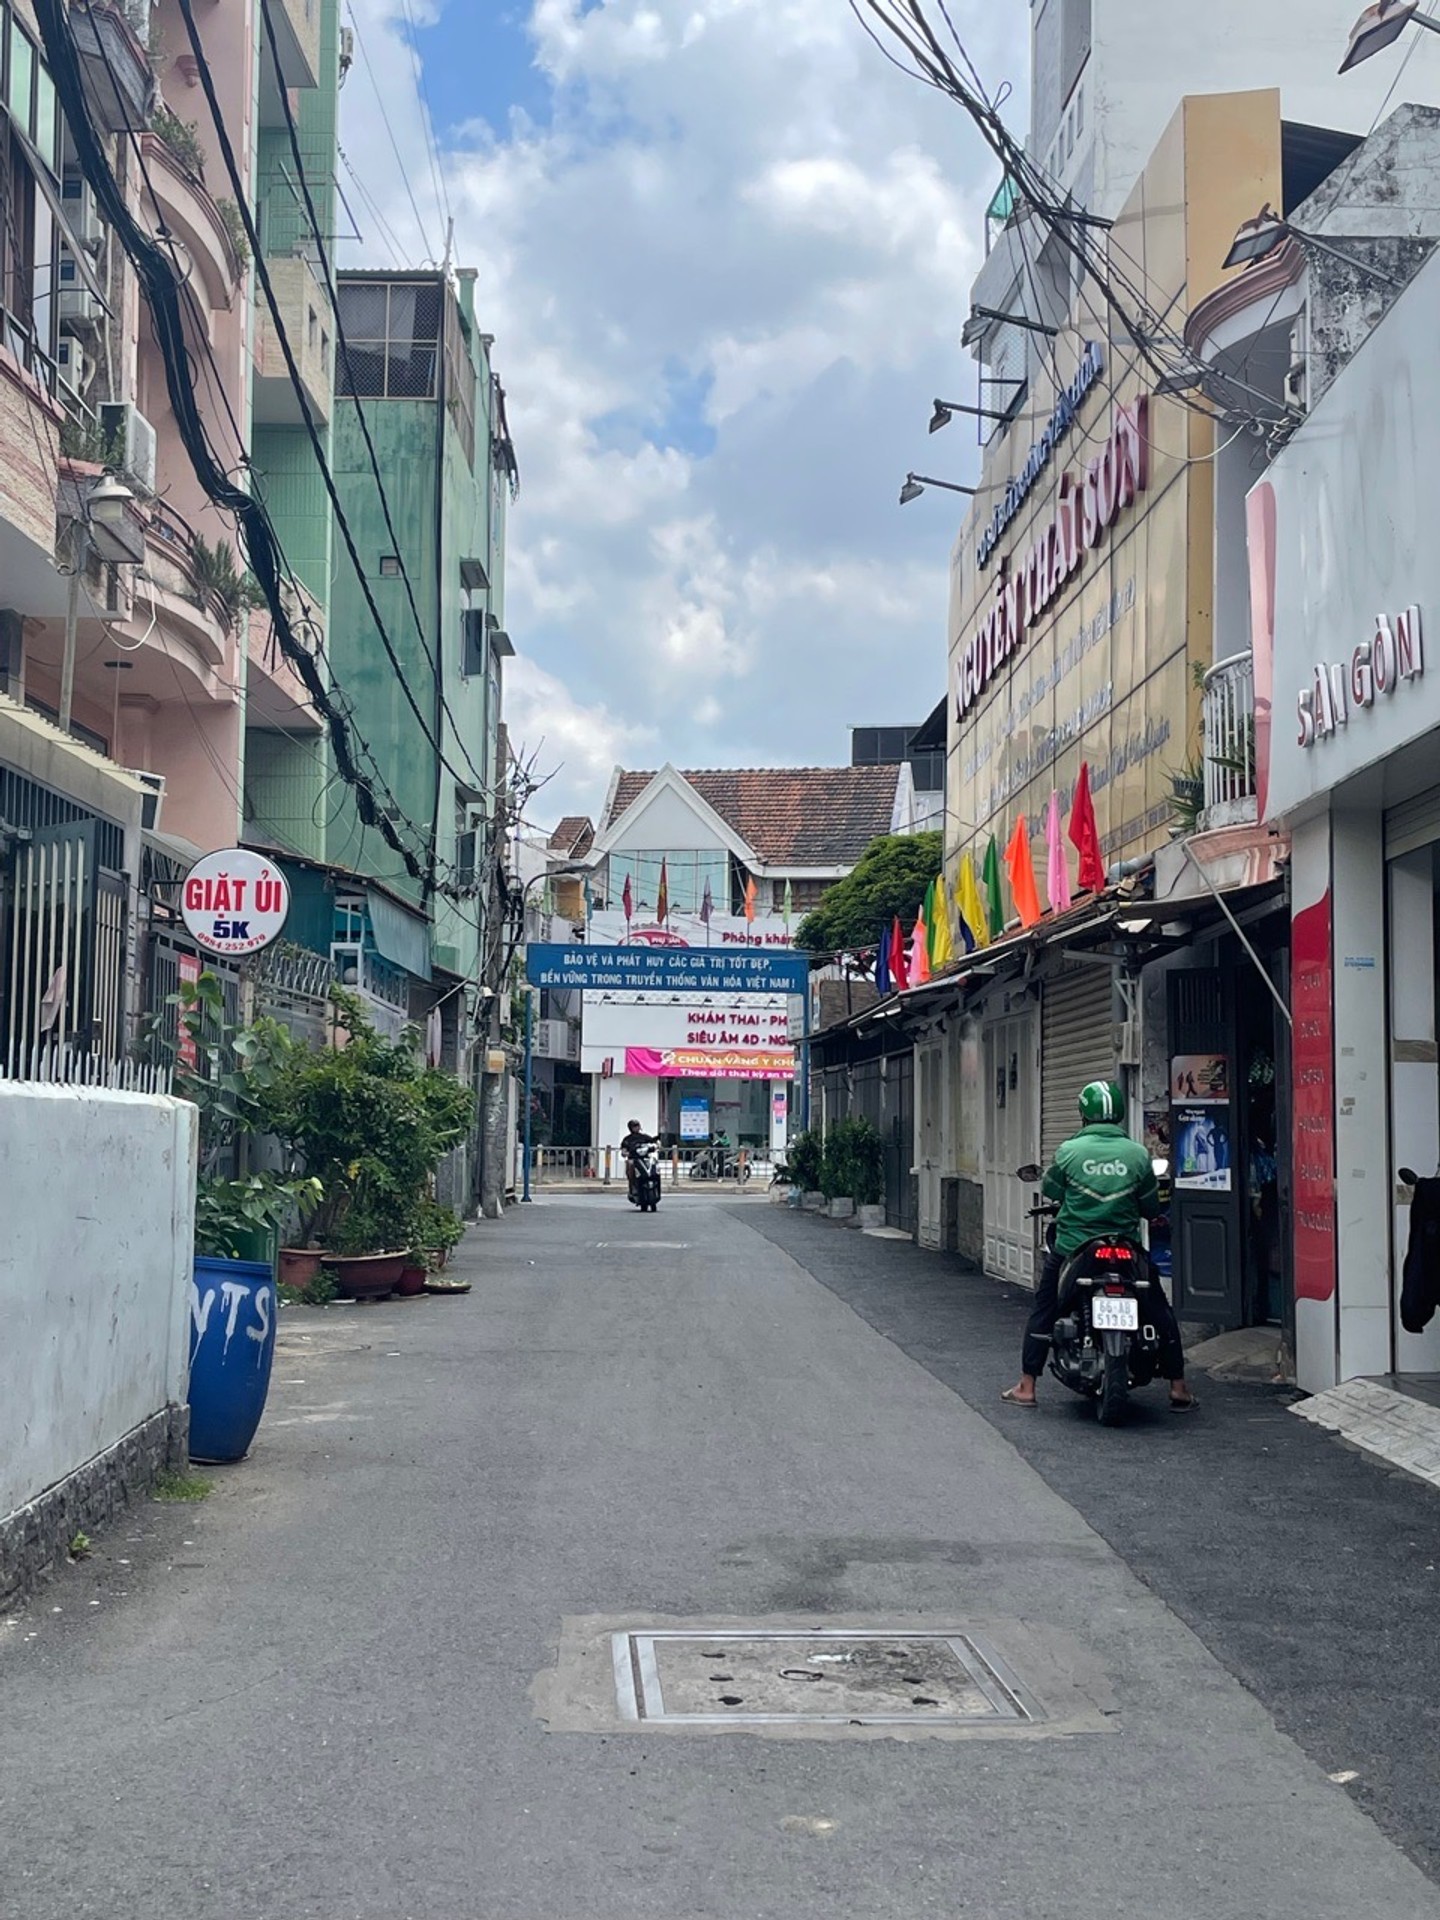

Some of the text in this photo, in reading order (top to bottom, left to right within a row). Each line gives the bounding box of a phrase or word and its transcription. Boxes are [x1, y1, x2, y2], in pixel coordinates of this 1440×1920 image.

[1021, 473, 1083, 628] THÁI
[1297, 605, 1423, 748] SÀI GÒN
[186, 869, 282, 918] GIẶT ỦI
[213, 921, 250, 939] 5K
[723, 931, 762, 946] Phòng
[564, 950, 583, 965] BẢO
[586, 952, 598, 967] VỆ
[601, 952, 614, 966] VÀ
[616, 952, 641, 966] PHÁT
[646, 955, 664, 967] HUY
[669, 954, 688, 967] CÁC
[729, 953, 747, 969] TỐT
[591, 973, 622, 985] TRONG
[665, 971, 697, 987] THỐNG
[700, 973, 719, 987] VĂN
[723, 973, 742, 988] HÓA
[746, 975, 766, 990] VIỆT
[688, 1010, 725, 1024] KHÁM
[729, 1014, 760, 1026] THAI
[687, 1030, 716, 1044] SIÊU
[719, 1030, 738, 1044] ÂM
[742, 1034, 760, 1045] 4D
[762, 1058, 770, 1067] Y
[680, 1067, 708, 1077] Theo
[728, 1069, 750, 1078] thai
[766, 1071, 780, 1079] an
[1082, 1159, 1128, 1176] Grab
